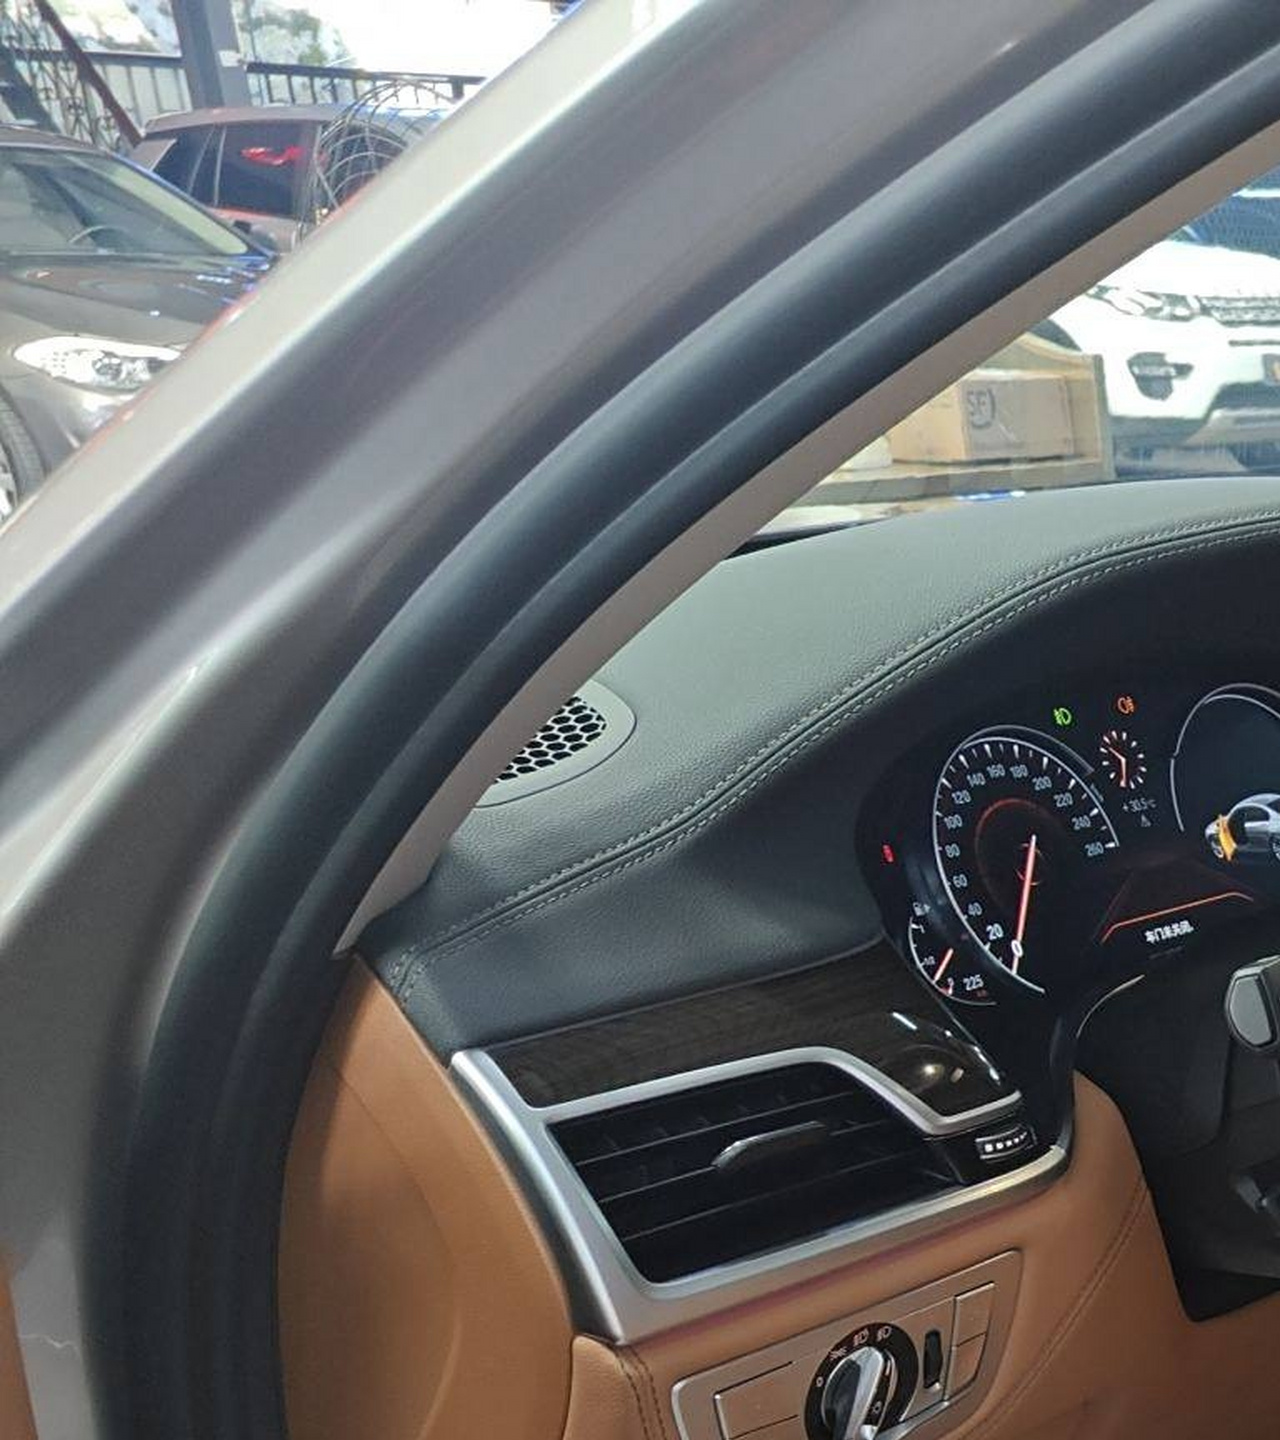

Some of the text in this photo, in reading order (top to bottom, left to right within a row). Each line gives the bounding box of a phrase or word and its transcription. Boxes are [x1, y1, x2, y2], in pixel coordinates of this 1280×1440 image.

[987, 764, 1005, 778] 160
[1010, 764, 1028, 778] 180
[967, 772, 986, 787] 140
[1032, 776, 1052, 790] 200
[951, 790, 971, 804] 120
[1054, 792, 1073, 807] 220
[944, 814, 962, 829] 100
[1072, 815, 1091, 830] 240
[945, 843, 960, 858] 80
[1085, 842, 1104, 857] 260
[952, 873, 968, 888] 60
[968, 902, 983, 916] 40
[986, 923, 1003, 940] 20
[1011, 939, 1023, 957] 0
[963, 974, 984, 991] 225
